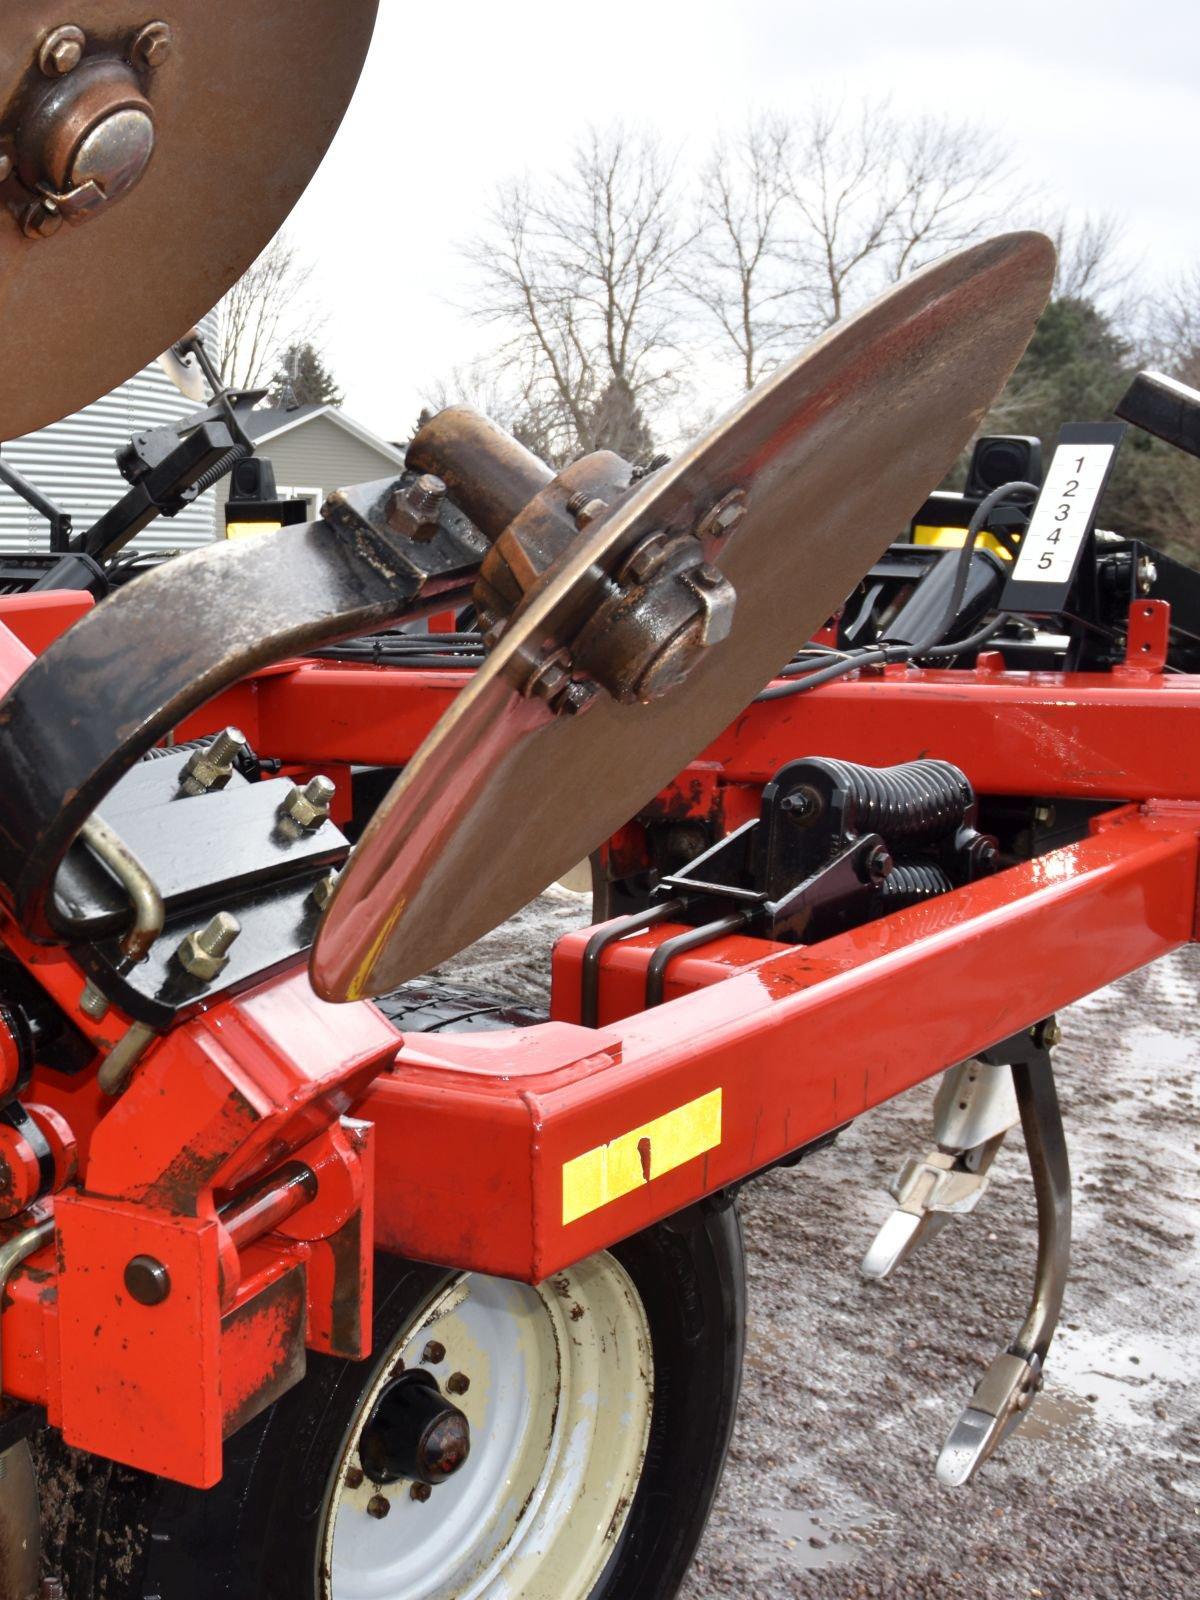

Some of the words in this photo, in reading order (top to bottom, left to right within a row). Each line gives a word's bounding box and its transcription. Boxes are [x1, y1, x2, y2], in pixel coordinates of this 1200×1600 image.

[1075, 456, 1085, 473] 1
[1062, 480, 1079, 497] 2
[1054, 504, 1070, 521] 3
[1047, 528, 1062, 545] 4
[1037, 552, 1054, 569] 5
